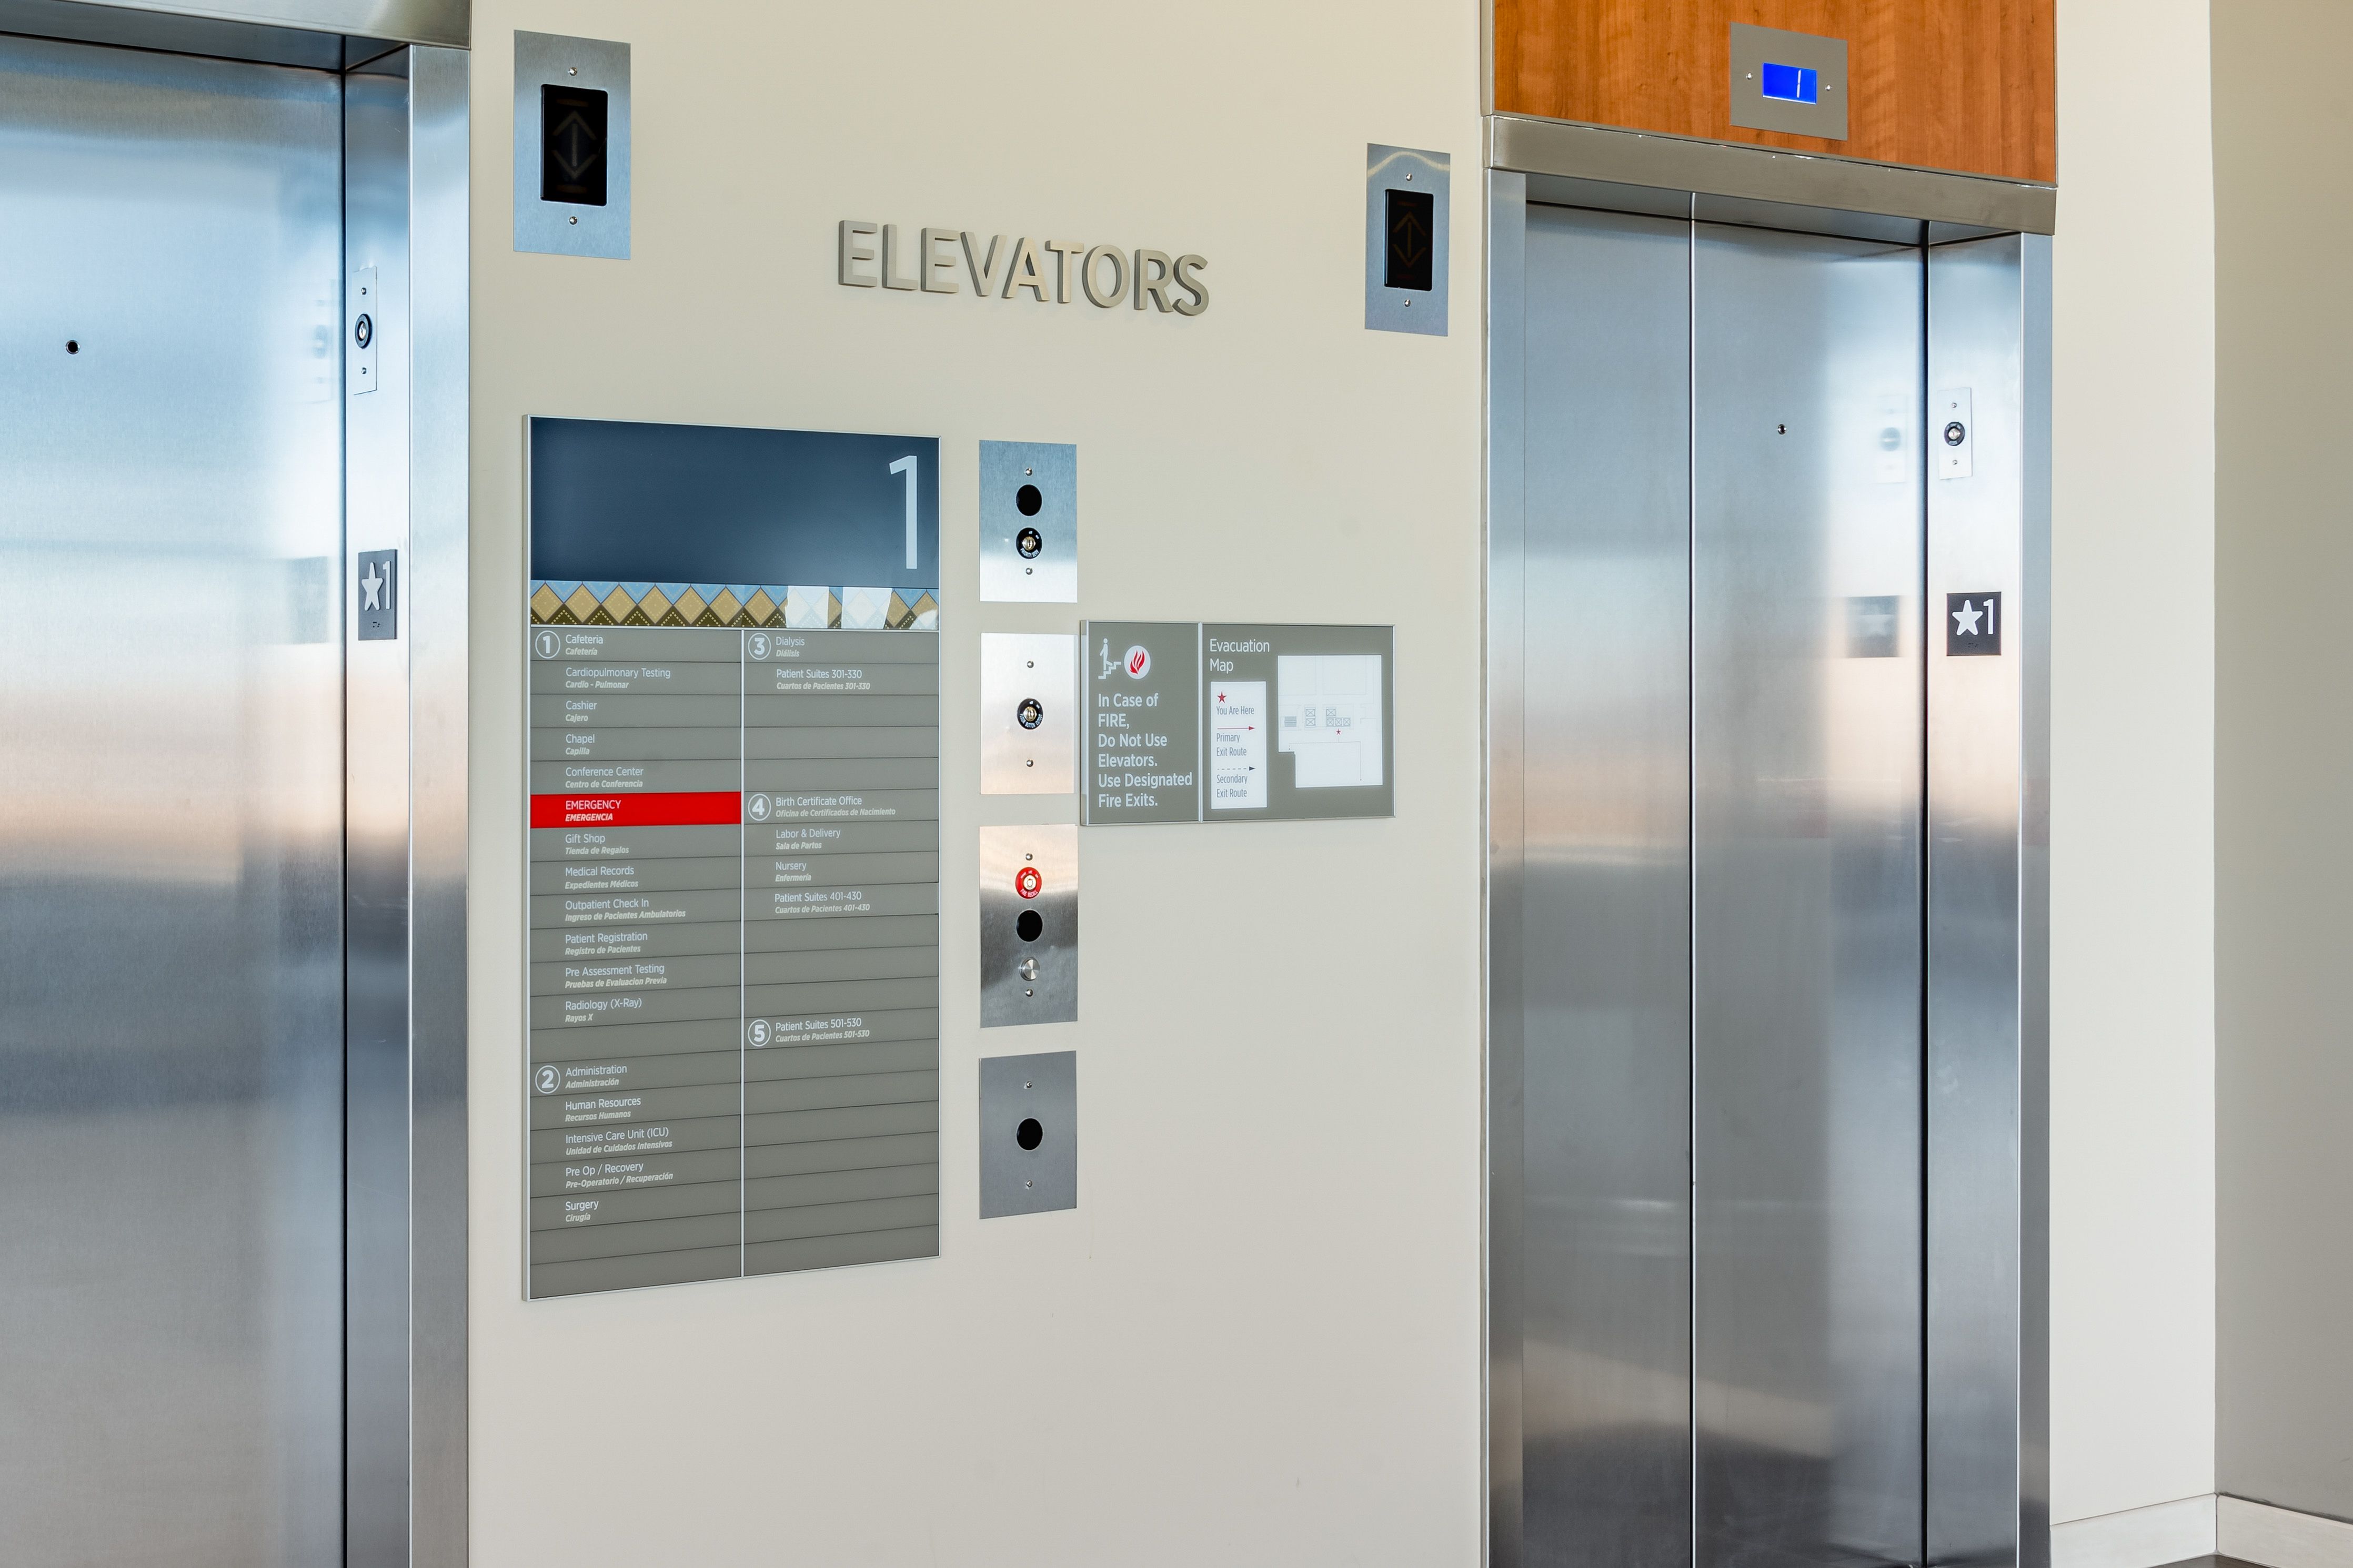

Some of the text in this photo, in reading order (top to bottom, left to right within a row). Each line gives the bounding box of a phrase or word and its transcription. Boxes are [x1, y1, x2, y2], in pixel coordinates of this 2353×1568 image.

[839, 220, 1209, 316] ELEVATORS
[889, 455, 917, 569] 1
[383, 561, 390, 610] 1
[1983, 599, 1993, 634] 1
[543, 636, 550, 653] 1
[566, 634, 603, 644] Cafeteria
[776, 636, 805, 647] Dialysis
[754, 638, 765, 655] 3
[1210, 639, 1269, 652] Evacuation
[1210, 659, 1233, 674] Map
[566, 667, 670, 679] Cardiopulmonary Testing
[777, 669, 862, 678] Patient Suites 301-330
[566, 701, 597, 710] Cashier
[1099, 693, 1158, 706] In Case of
[1216, 706, 1254, 715] You Are Here
[566, 714, 588, 723] Cajero
[1099, 714, 1129, 729] FIRE,
[566, 734, 595, 744] Chapel
[1099, 733, 1167, 747] Do Not Use
[1216, 733, 1240, 743] Primary
[566, 747, 589, 756] Capilla
[1216, 747, 1246, 756] Exit Route
[1099, 754, 1157, 767] Elevators.
[566, 767, 643, 776] Conference Center
[1099, 772, 1192, 788] Use Designated
[1217, 774, 1248, 784] Secondary
[1217, 788, 1246, 797] Exit Route
[566, 800, 621, 810] EMERGENCY
[776, 796, 862, 806] Birth Certificate Office
[1099, 793, 1158, 807] Fire Exits.
[752, 798, 765, 815] 4
[566, 834, 605, 844] Gift Shop
[777, 828, 840, 838] Labor & Delivery
[601, 846, 629, 855] Regalos
[566, 866, 634, 876] Medical Records
[776, 862, 806, 871] Nursery
[565, 881, 608, 890] Expedientes
[775, 892, 861, 902] Patient Suites 401-430
[566, 898, 649, 911] Outpatient Check In
[639, 909, 686, 918] Ambulatorios
[566, 932, 647, 944] Patient Registration
[565, 947, 595, 956] Registro
[566, 964, 664, 977] Pre Assessment Testing
[606, 978, 643, 986] Evaluacion
[566, 998, 641, 1010] Radiology (X-Ray)
[776, 1018, 861, 1031] Patient Suites 501-530
[754, 1025, 765, 1041] 5
[566, 1065, 627, 1077] Administration
[542, 1070, 554, 1088] 2
[565, 1078, 619, 1088] Administración
[566, 1098, 641, 1110] Human Resources
[566, 1127, 669, 1143] Intensive Care Unit (ICU)
[566, 1146, 591, 1155] Unidad
[604, 1143, 636, 1152] Cuidados
[637, 1140, 672, 1149] Intensivos
[566, 1168, 580, 1176] Pre
[582, 1166, 595, 1176] Op
[605, 1164, 643, 1173] Recovery
[566, 1177, 619, 1188] Pre-Operatorio
[626, 1172, 673, 1183] Recuperación
[566, 1201, 599, 1211] Surgery
[566, 1212, 590, 1222] Cirugía
